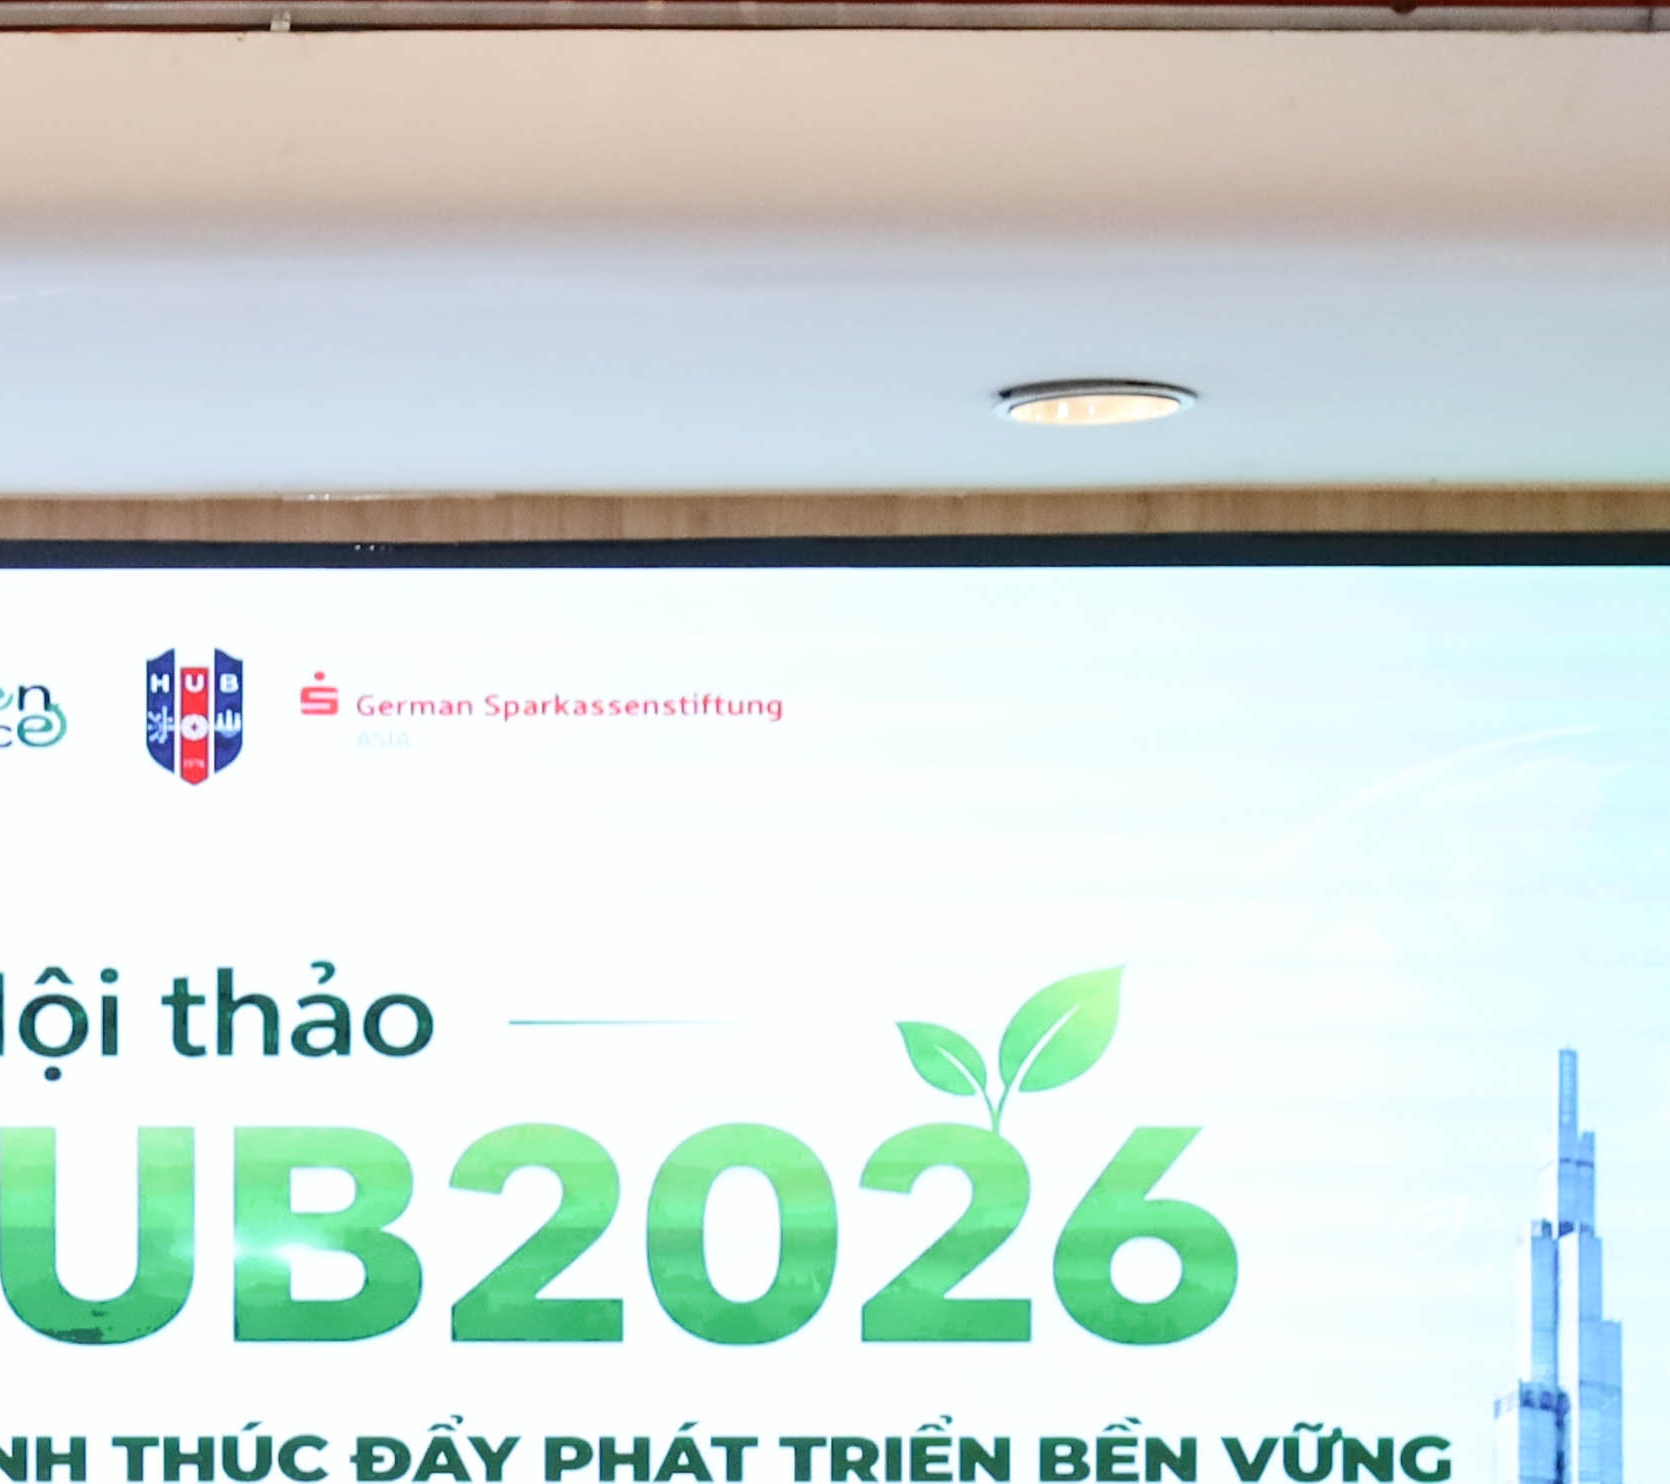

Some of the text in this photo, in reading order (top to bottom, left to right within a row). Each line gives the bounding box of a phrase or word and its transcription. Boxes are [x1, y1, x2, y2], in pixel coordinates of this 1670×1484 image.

[150, 673, 239, 694] HUB
[357, 693, 784, 723] German Sparkassenstiftung
[162, 961, 434, 1058] thảo
[111, 1422, 328, 1483] THÚC
[350, 1415, 520, 1482] ĐẨY
[544, 1422, 759, 1482] PHÁT
[779, 1415, 1011, 1482] TRIỂN
[1039, 1416, 1197, 1483] BỀN
[1221, 1422, 1451, 1483] VỮNG
